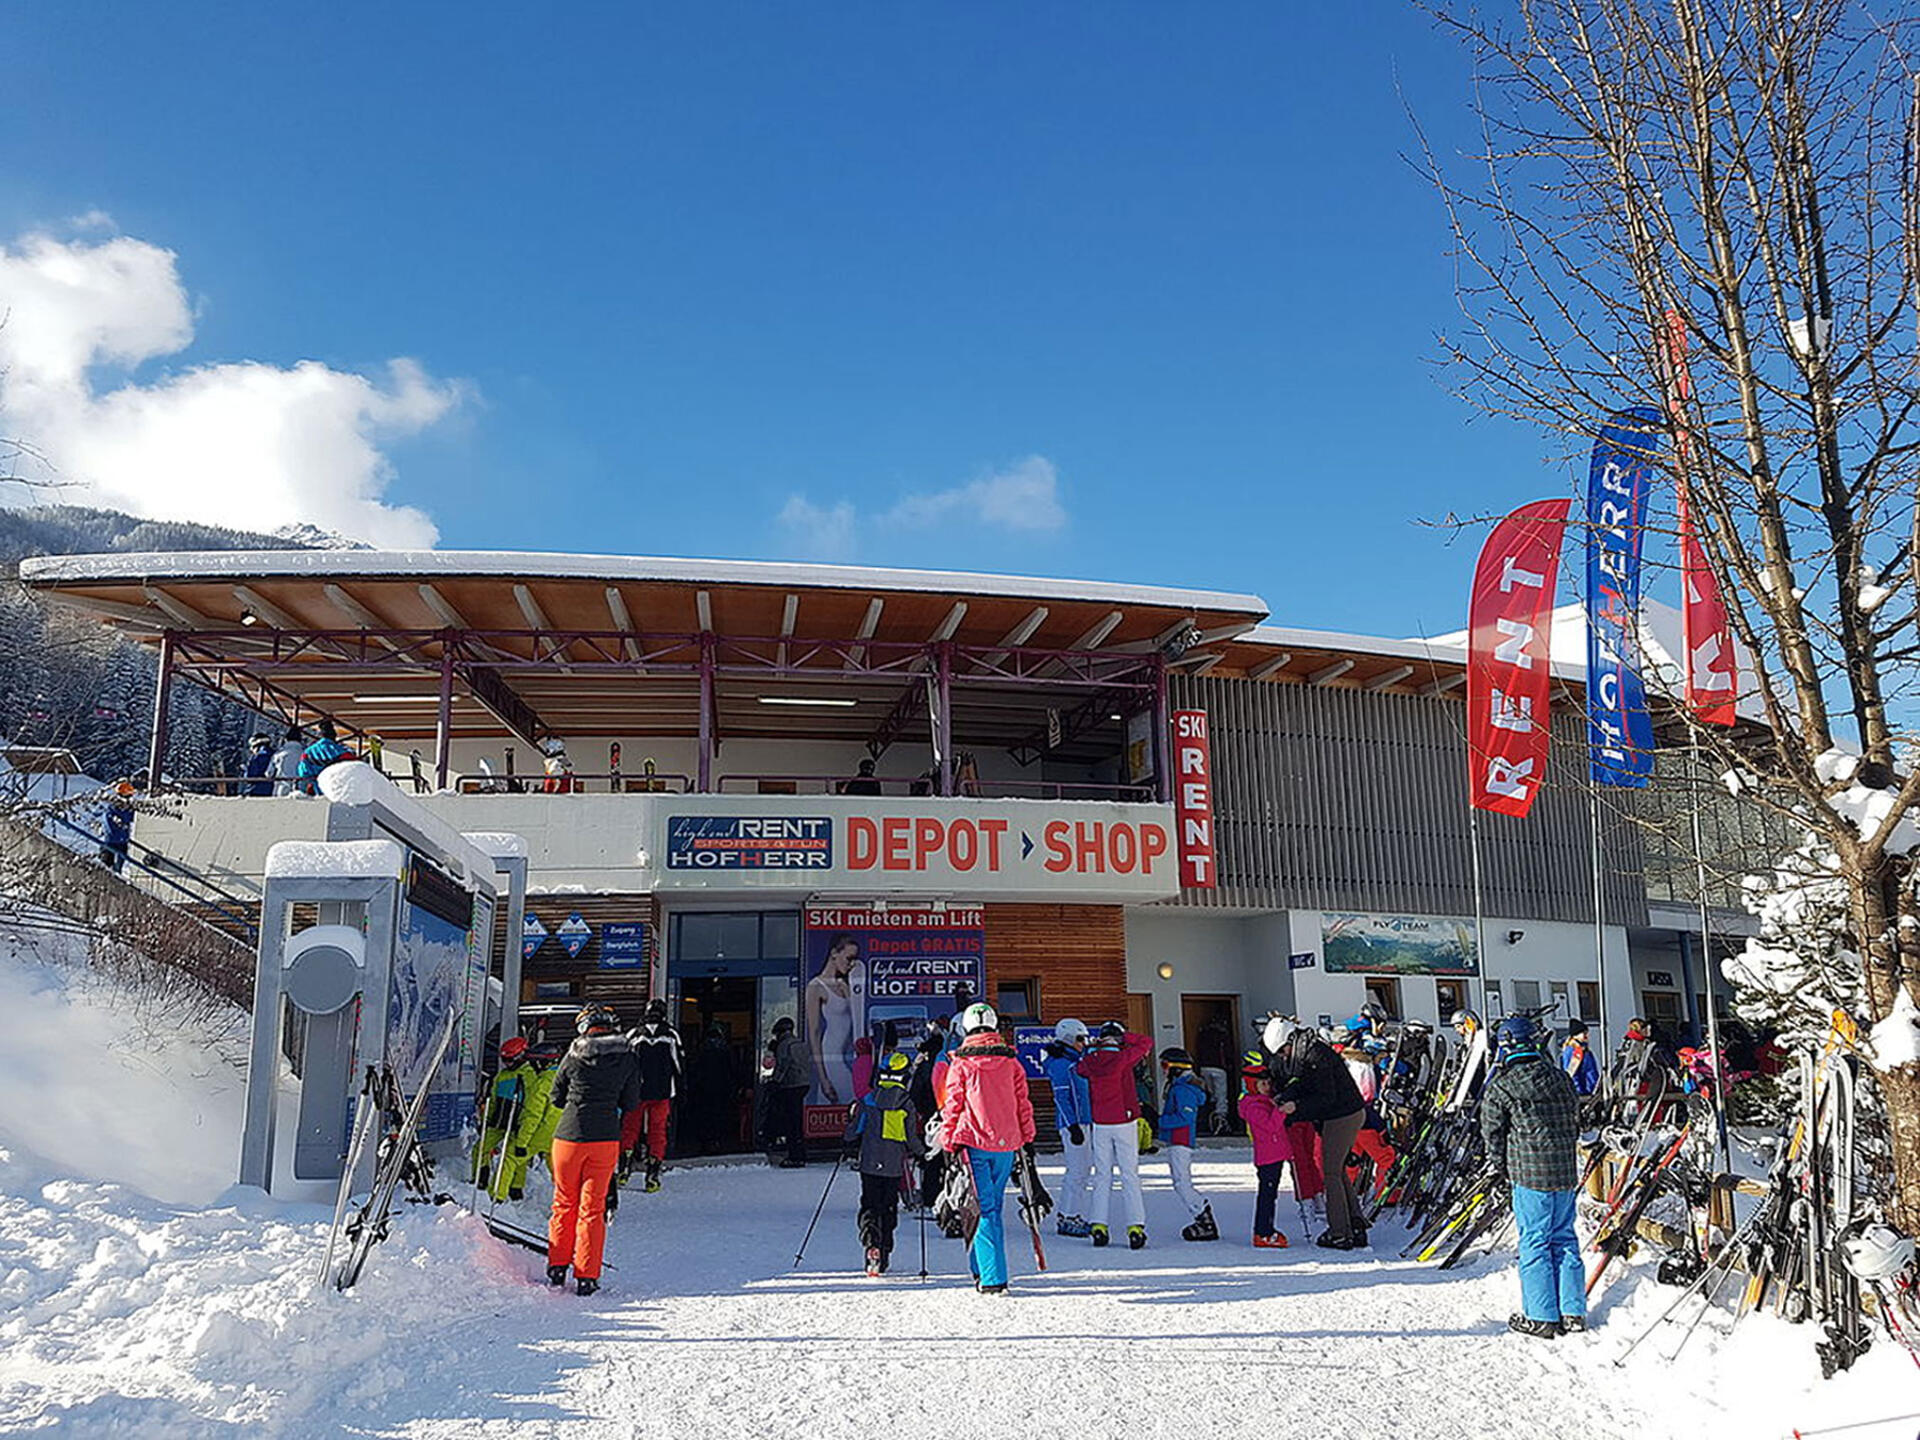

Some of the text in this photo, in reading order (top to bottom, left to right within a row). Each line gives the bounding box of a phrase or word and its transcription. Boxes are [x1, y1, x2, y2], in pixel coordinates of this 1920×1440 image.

[1485, 556, 1545, 800] RENT
[1179, 715, 1205, 738] SKI
[1182, 747, 1210, 882] RENT
[738, 819, 824, 838] RENT
[695, 839, 772, 848] SPORTS
[788, 839, 828, 848] FUN
[847, 816, 1167, 874] DEPOT SHOP
[671, 851, 828, 866] HOFHERR
[809, 911, 982, 926] SKI mieten am Lift
[1402, 921, 1430, 931] TEAM
[868, 938, 981, 954] Depot GRATIS
[916, 961, 973, 974] RENT
